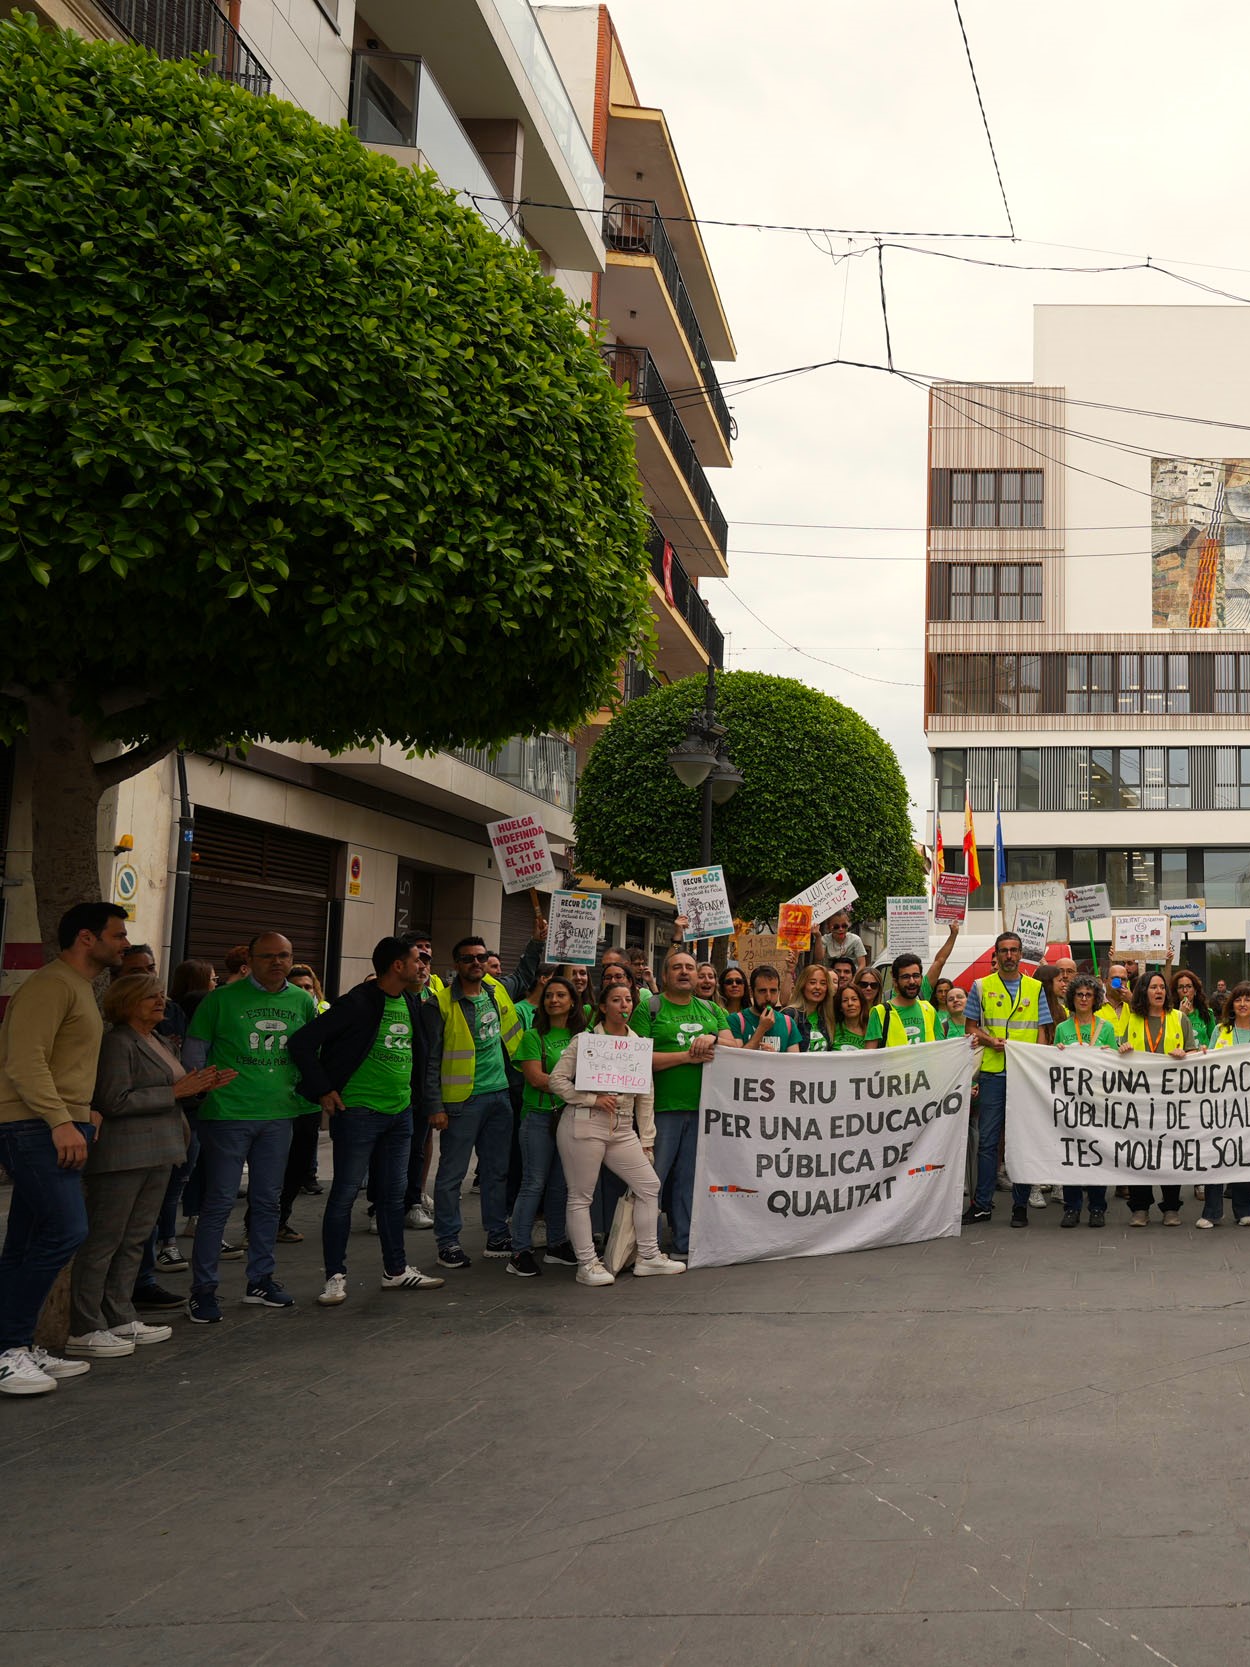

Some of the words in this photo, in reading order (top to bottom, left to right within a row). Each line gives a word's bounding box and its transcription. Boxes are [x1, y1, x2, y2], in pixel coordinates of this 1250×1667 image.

[498, 816, 534, 833] HUELGA
[492, 826, 544, 846] INDEFINIDA
[506, 840, 535, 855] DESDE
[505, 858, 517, 868] EL
[519, 854, 532, 864] 11
[533, 849, 545, 860] DE
[515, 863, 542, 877] MAYO
[790, 911, 803, 924] 27
[1020, 918, 1044, 932] VAGA
[615, 1040, 628, 1050] NO
[597, 1073, 646, 1087] EJEMPLO
[733, 1077, 776, 1103] IES
[789, 1079, 837, 1105] RIU
[850, 1070, 931, 1101] TÚRIA
[1049, 1066, 1094, 1097] PER
[1102, 1068, 1150, 1096] UNA
[704, 1109, 752, 1139] PER
[759, 1116, 823, 1141] UNA
[831, 1084, 964, 1139] EDUCACIÓ
[1053, 1095, 1139, 1130] PÚBLICA
[1166, 1100, 1191, 1130] DE
[756, 1147, 875, 1179] PÚBLICA
[883, 1141, 914, 1169] DE
[1060, 1137, 1103, 1168] IES
[1114, 1133, 1167, 1171] MOLÍ
[1172, 1139, 1207, 1172] DEL
[767, 1176, 898, 1219] QUALITAT
